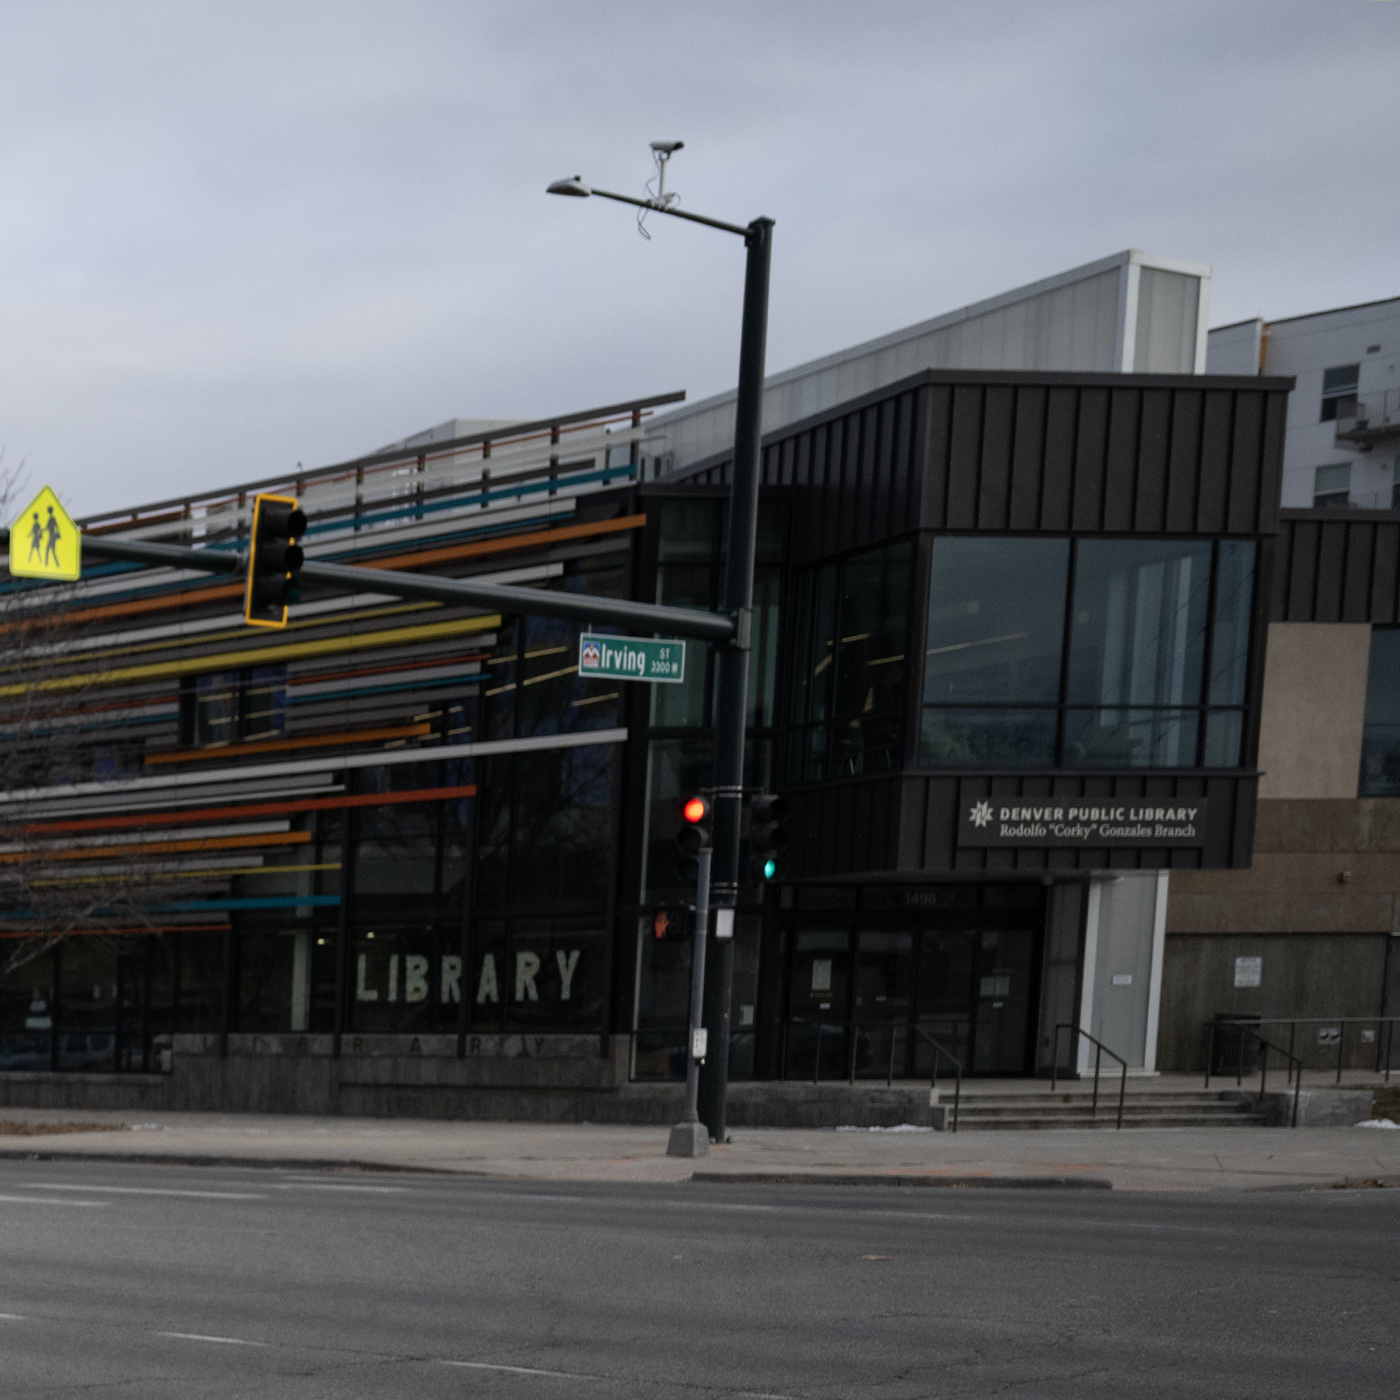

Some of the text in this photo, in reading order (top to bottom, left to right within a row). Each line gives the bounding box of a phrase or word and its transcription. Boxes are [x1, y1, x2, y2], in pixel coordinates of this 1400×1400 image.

[601, 643, 646, 677] Irving
[660, 648, 671, 660] ST
[651, 660, 679, 674] 3300 W
[1000, 806, 1198, 822] DENVER PUBLIC LIBRARY
[1000, 823, 1047, 838] Rodolfo
[1099, 823, 1153, 839] Gonzales
[1154, 823, 1196, 839] Branch
[356, 949, 581, 1004] LIBRARY
